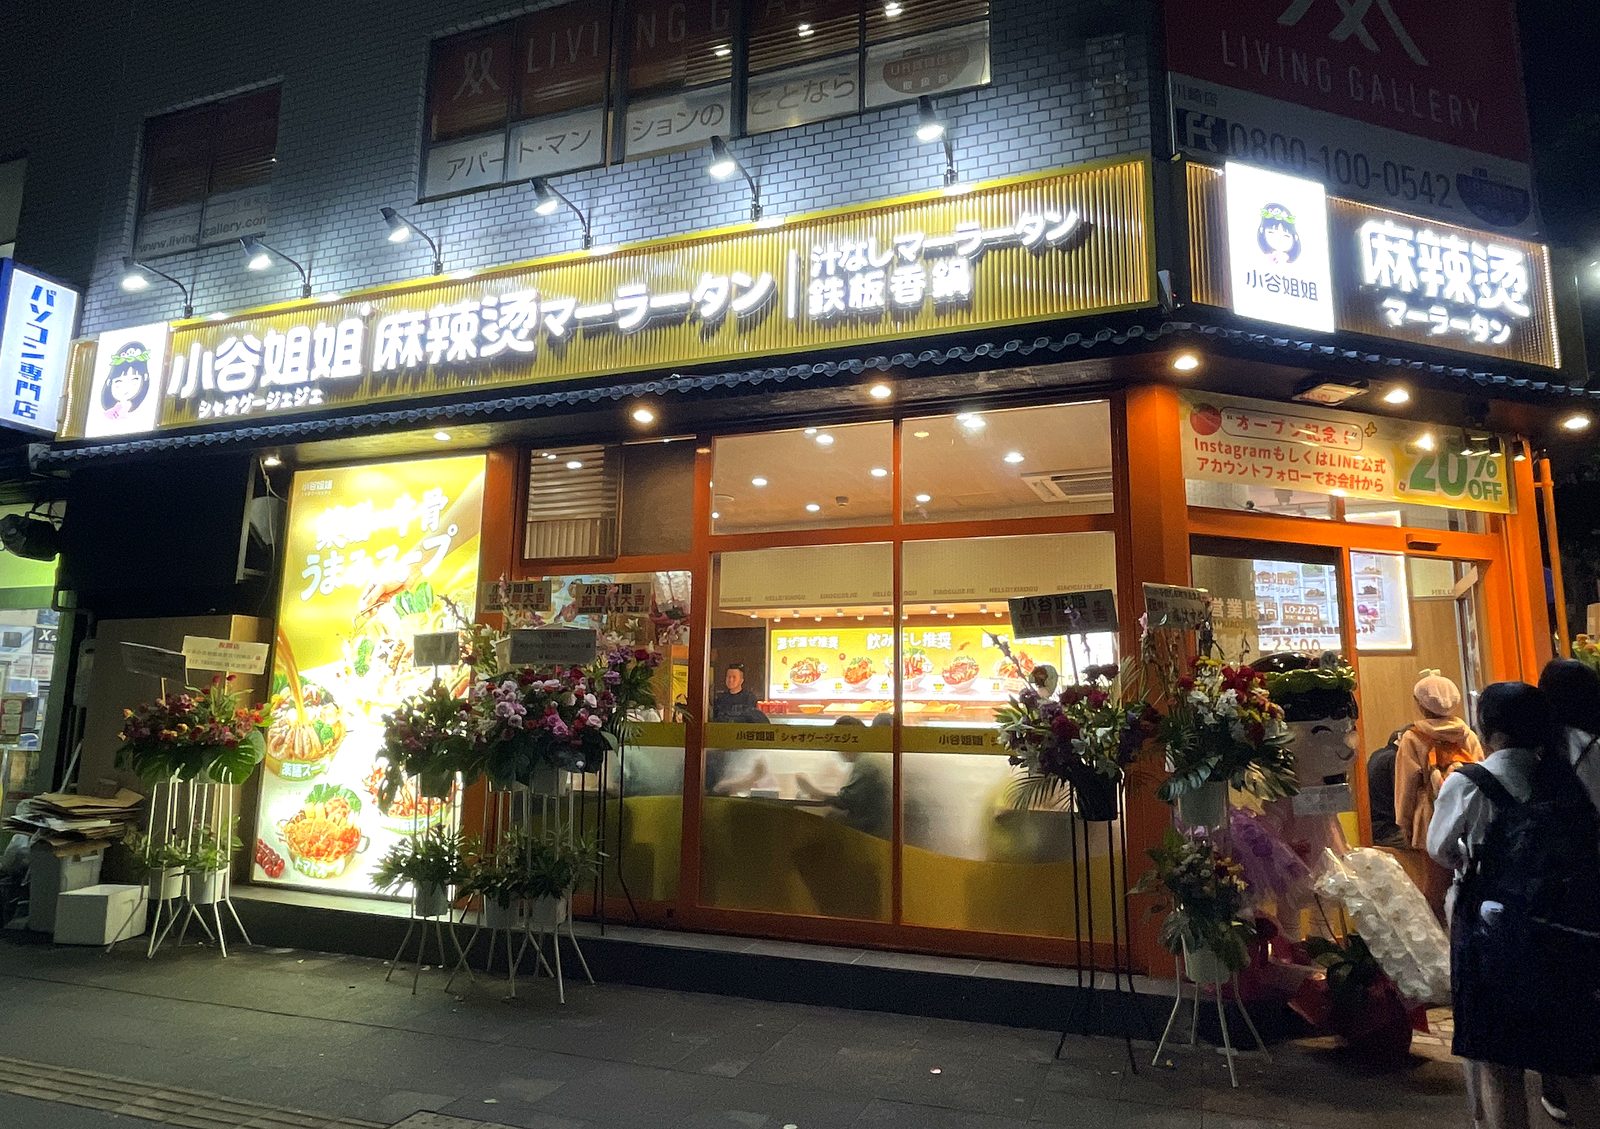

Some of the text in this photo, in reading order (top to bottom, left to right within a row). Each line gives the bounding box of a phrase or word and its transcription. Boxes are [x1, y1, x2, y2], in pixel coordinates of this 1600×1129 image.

[1221, 29, 1482, 132] LIVING GALLERY
[1228, 121, 1453, 209] 0800-100-0542
[810, 210, 1079, 279] 汁なしマーラータン
[1246, 276, 1320, 302] 小谷姐姐
[1382, 297, 1511, 344] マーラータン
[12, 284, 57, 420] パソコン専門店
[167, 318, 365, 399] 小谷姐姐
[1197, 456, 1385, 494] アカウントフォローでお会計から
[1468, 479, 1503, 501] OFF
